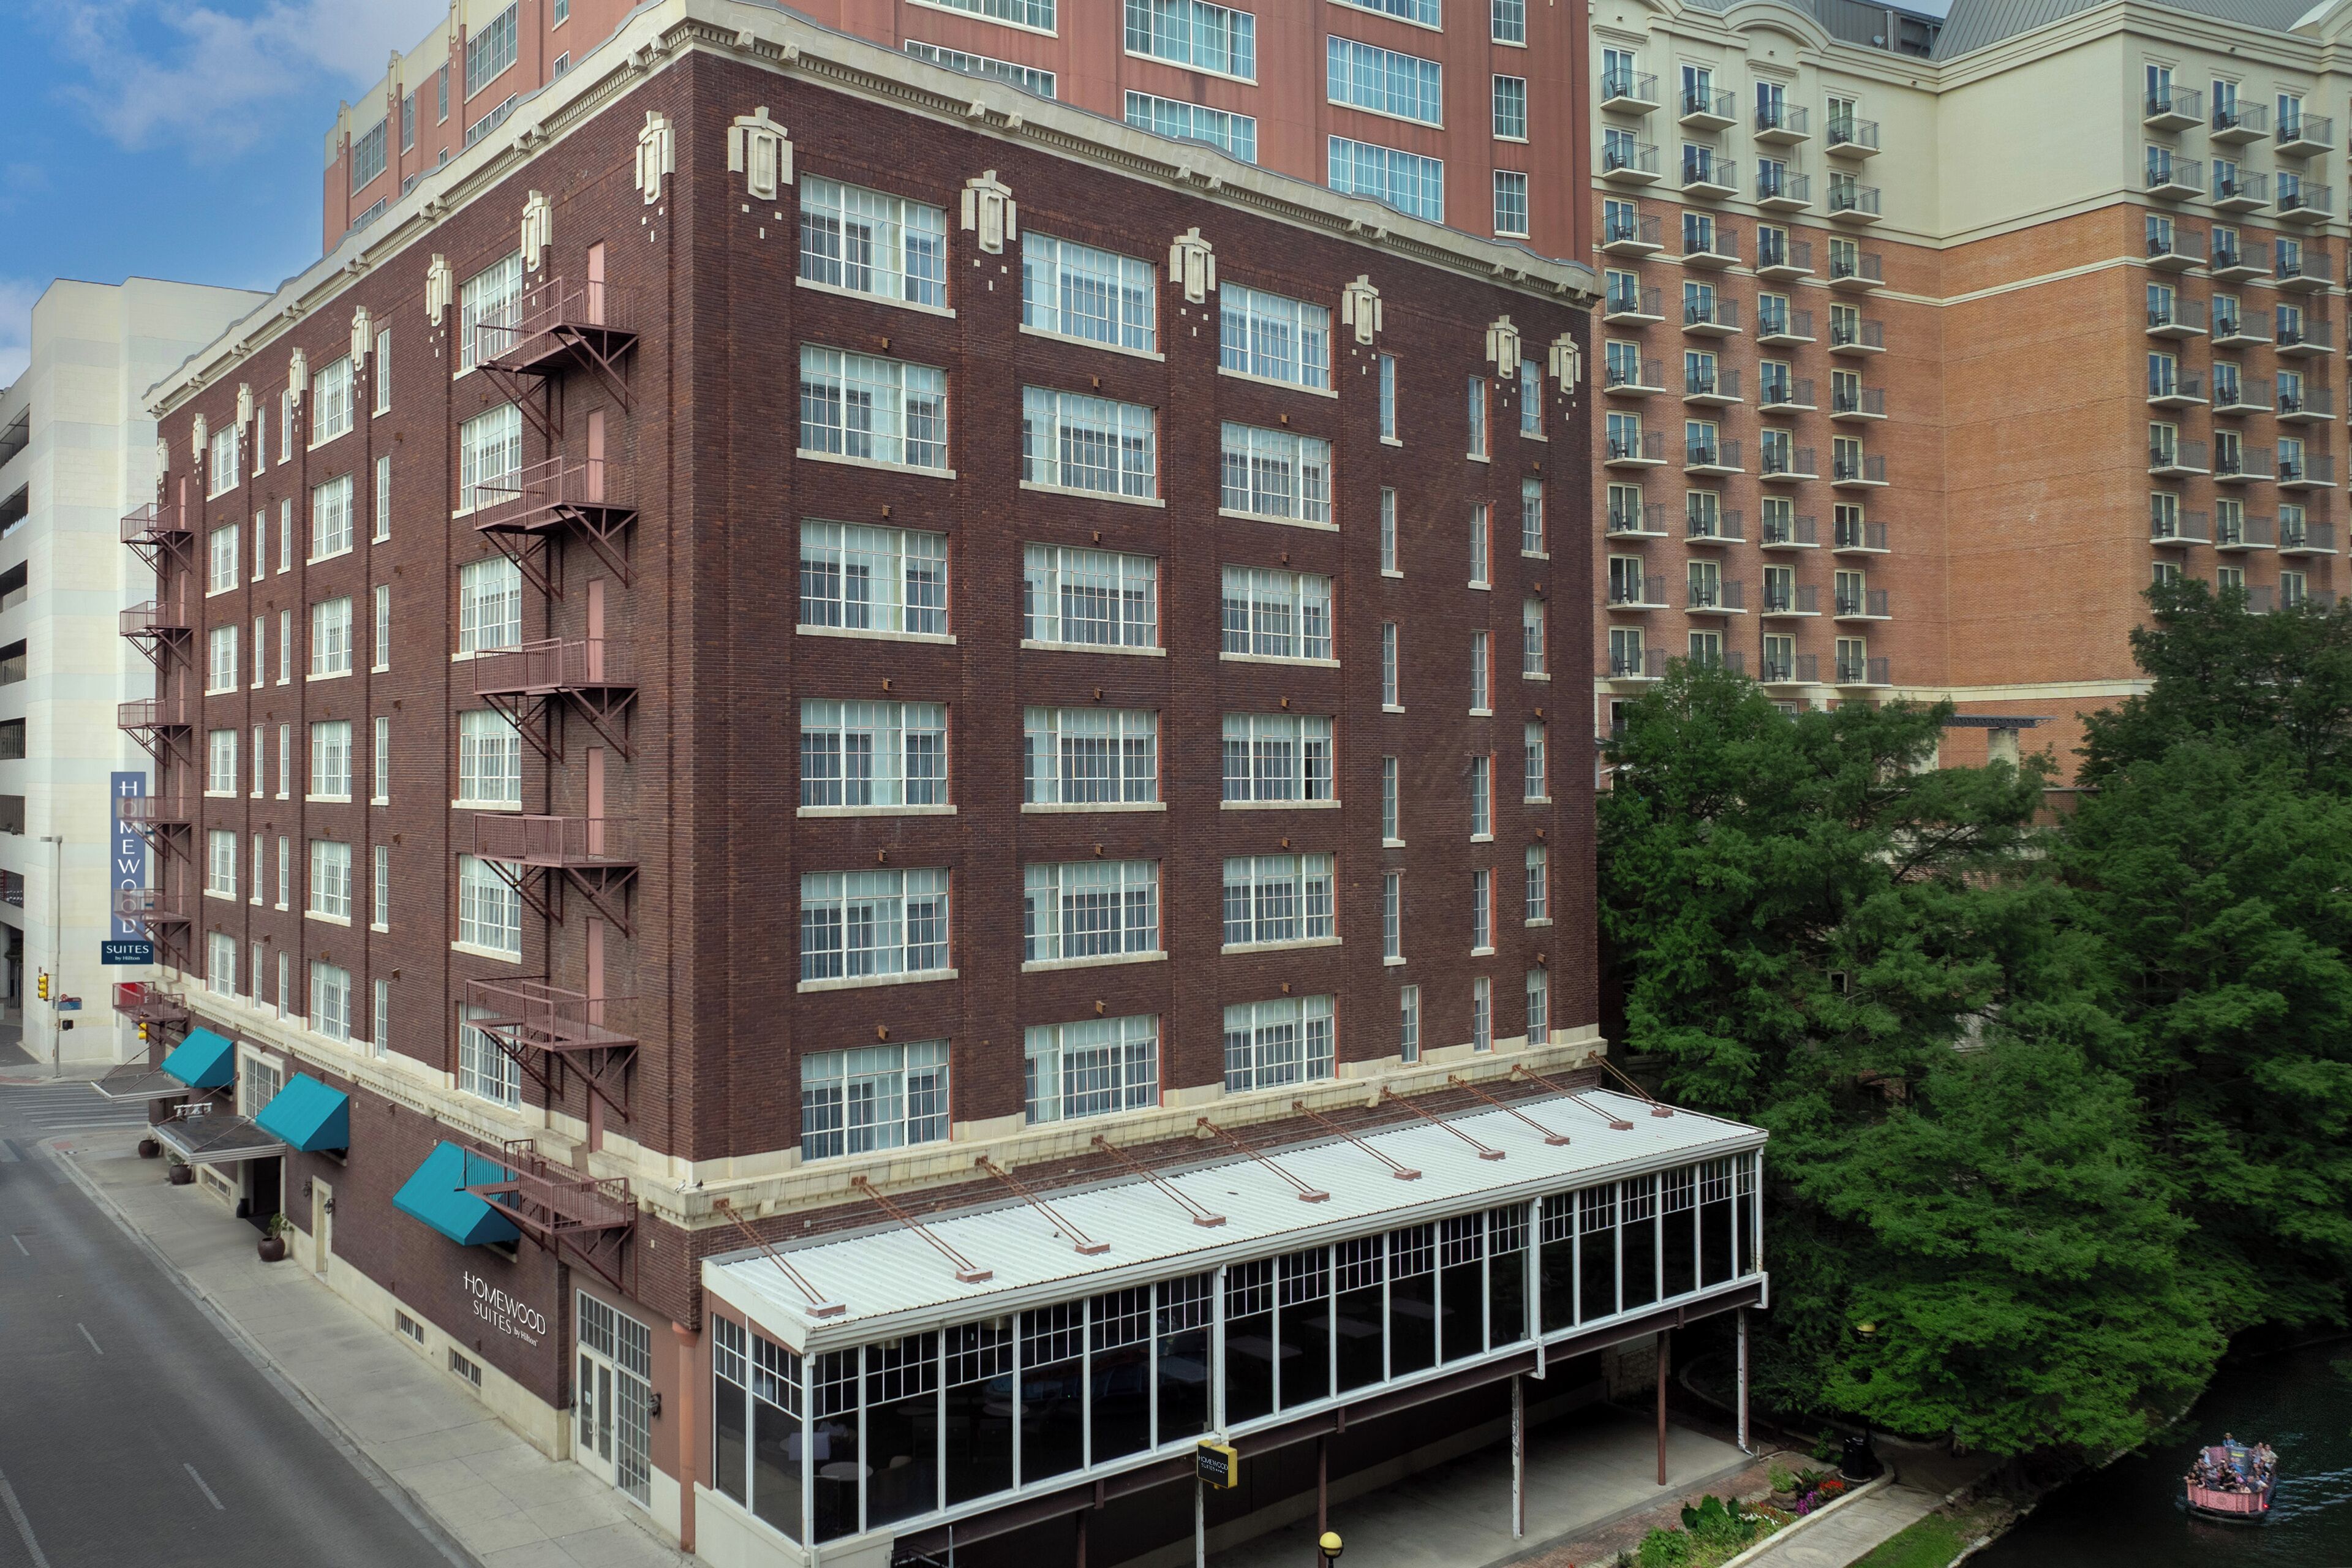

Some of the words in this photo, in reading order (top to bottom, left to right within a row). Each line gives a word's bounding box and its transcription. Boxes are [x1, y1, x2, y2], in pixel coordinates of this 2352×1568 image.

[118, 781, 140, 933] HOMEWOOD
[106, 945, 149, 954] SUITES
[463, 1271, 546, 1335] HOMEWOOD
[473, 1300, 511, 1334] SUITES
[514, 1326, 521, 1338] by
[1198, 1455, 1228, 1471] HOMEWOOD
